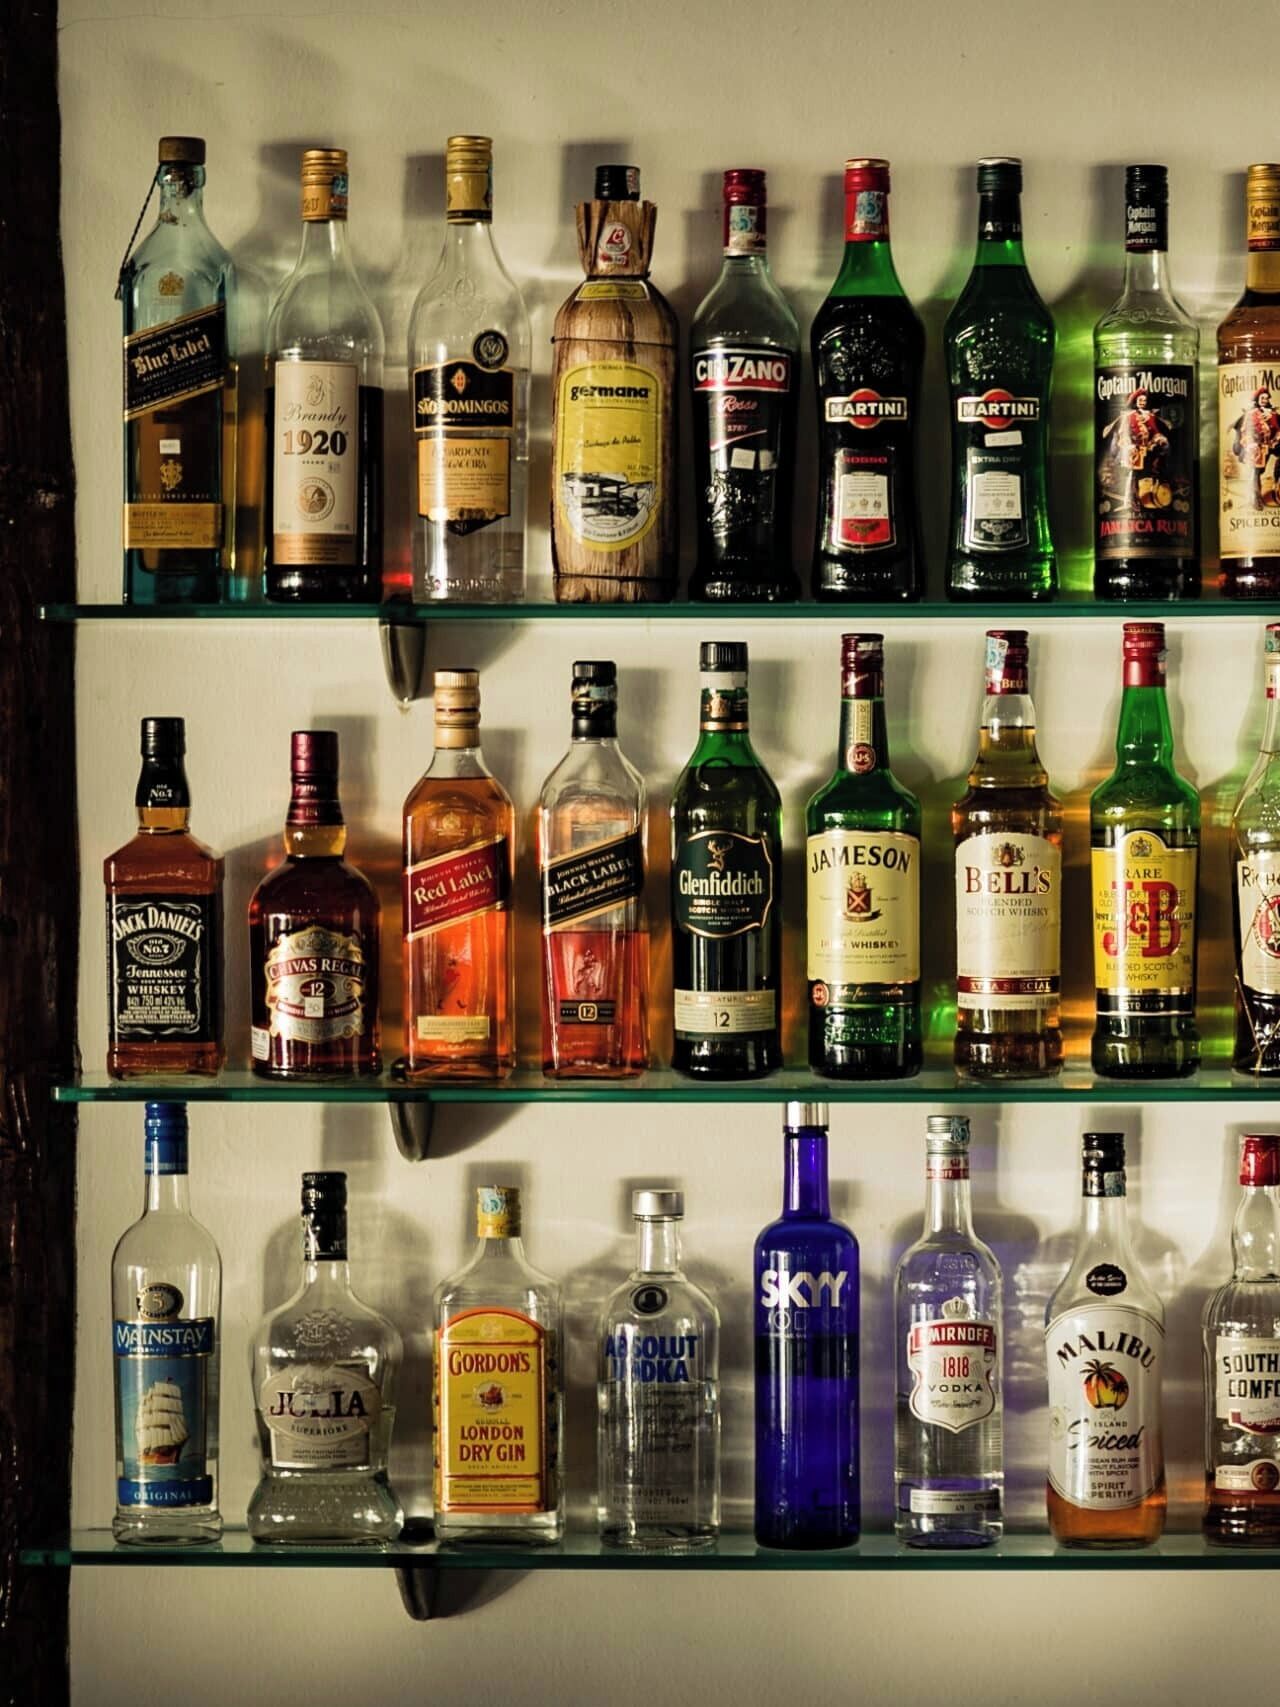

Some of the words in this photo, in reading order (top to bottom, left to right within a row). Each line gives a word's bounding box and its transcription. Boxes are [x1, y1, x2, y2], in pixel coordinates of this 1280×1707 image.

[1127, 205, 1156, 220] Captain
[1251, 205, 1280, 220] Captain
[1127, 220, 1157, 235] Morgan
[131, 352, 169, 379] Blue
[168, 334, 211, 361] Label
[696, 355, 787, 383] CINZANO
[571, 386, 650, 401] germana
[1098, 376, 1136, 400] Captain
[1137, 371, 1188, 397] Morgan
[1221, 374, 1258, 397] Captain
[417, 397, 436, 414] SÃO
[831, 402, 902, 416] MARTINI
[963, 403, 1035, 417] MARTINI
[284, 403, 348, 428] Brandy
[283, 430, 347, 456] 1920
[1157, 520, 1188, 536] RUM
[1229, 516, 1269, 531] SPICED
[811, 844, 911, 874] JAMESON
[546, 873, 589, 897] BLACK
[591, 857, 634, 880] LABEL
[965, 864, 1051, 895] BELL'S
[1124, 868, 1162, 879] RARE
[413, 880, 447, 905] Red
[449, 864, 494, 892] Label
[679, 869, 763, 896] Glenfiddich
[981, 898, 1033, 907] LENDED
[115, 912, 147, 941] JACK
[147, 906, 204, 941] DANIEL'S
[1103, 880, 1182, 958] J&B
[143, 944, 170, 954] No.7
[851, 940, 900, 949] WHISKEY
[126, 965, 187, 978] Tennessee
[320, 958, 362, 975] REGAL
[127, 985, 187, 995] WHISKEY
[309, 982, 325, 996] 12
[581, 1005, 595, 1018] 12
[713, 1011, 730, 1027] 12
[760, 1270, 848, 1308] SKYY
[116, 1324, 207, 1348] MAINSTAY
[919, 1326, 990, 1342] MIRNOFF
[605, 1335, 697, 1359] ABSOLUT
[1056, 1331, 1156, 1370] MALIBU
[449, 1350, 531, 1376] GORDON'S
[943, 1356, 970, 1378] 1818
[929, 1383, 983, 1393] VODKA
[460, 1425, 524, 1441] LONDON
[459, 1444, 493, 1461] DRY
[496, 1444, 526, 1461] GIN
[1086, 1490, 1134, 1499] PERITIF
